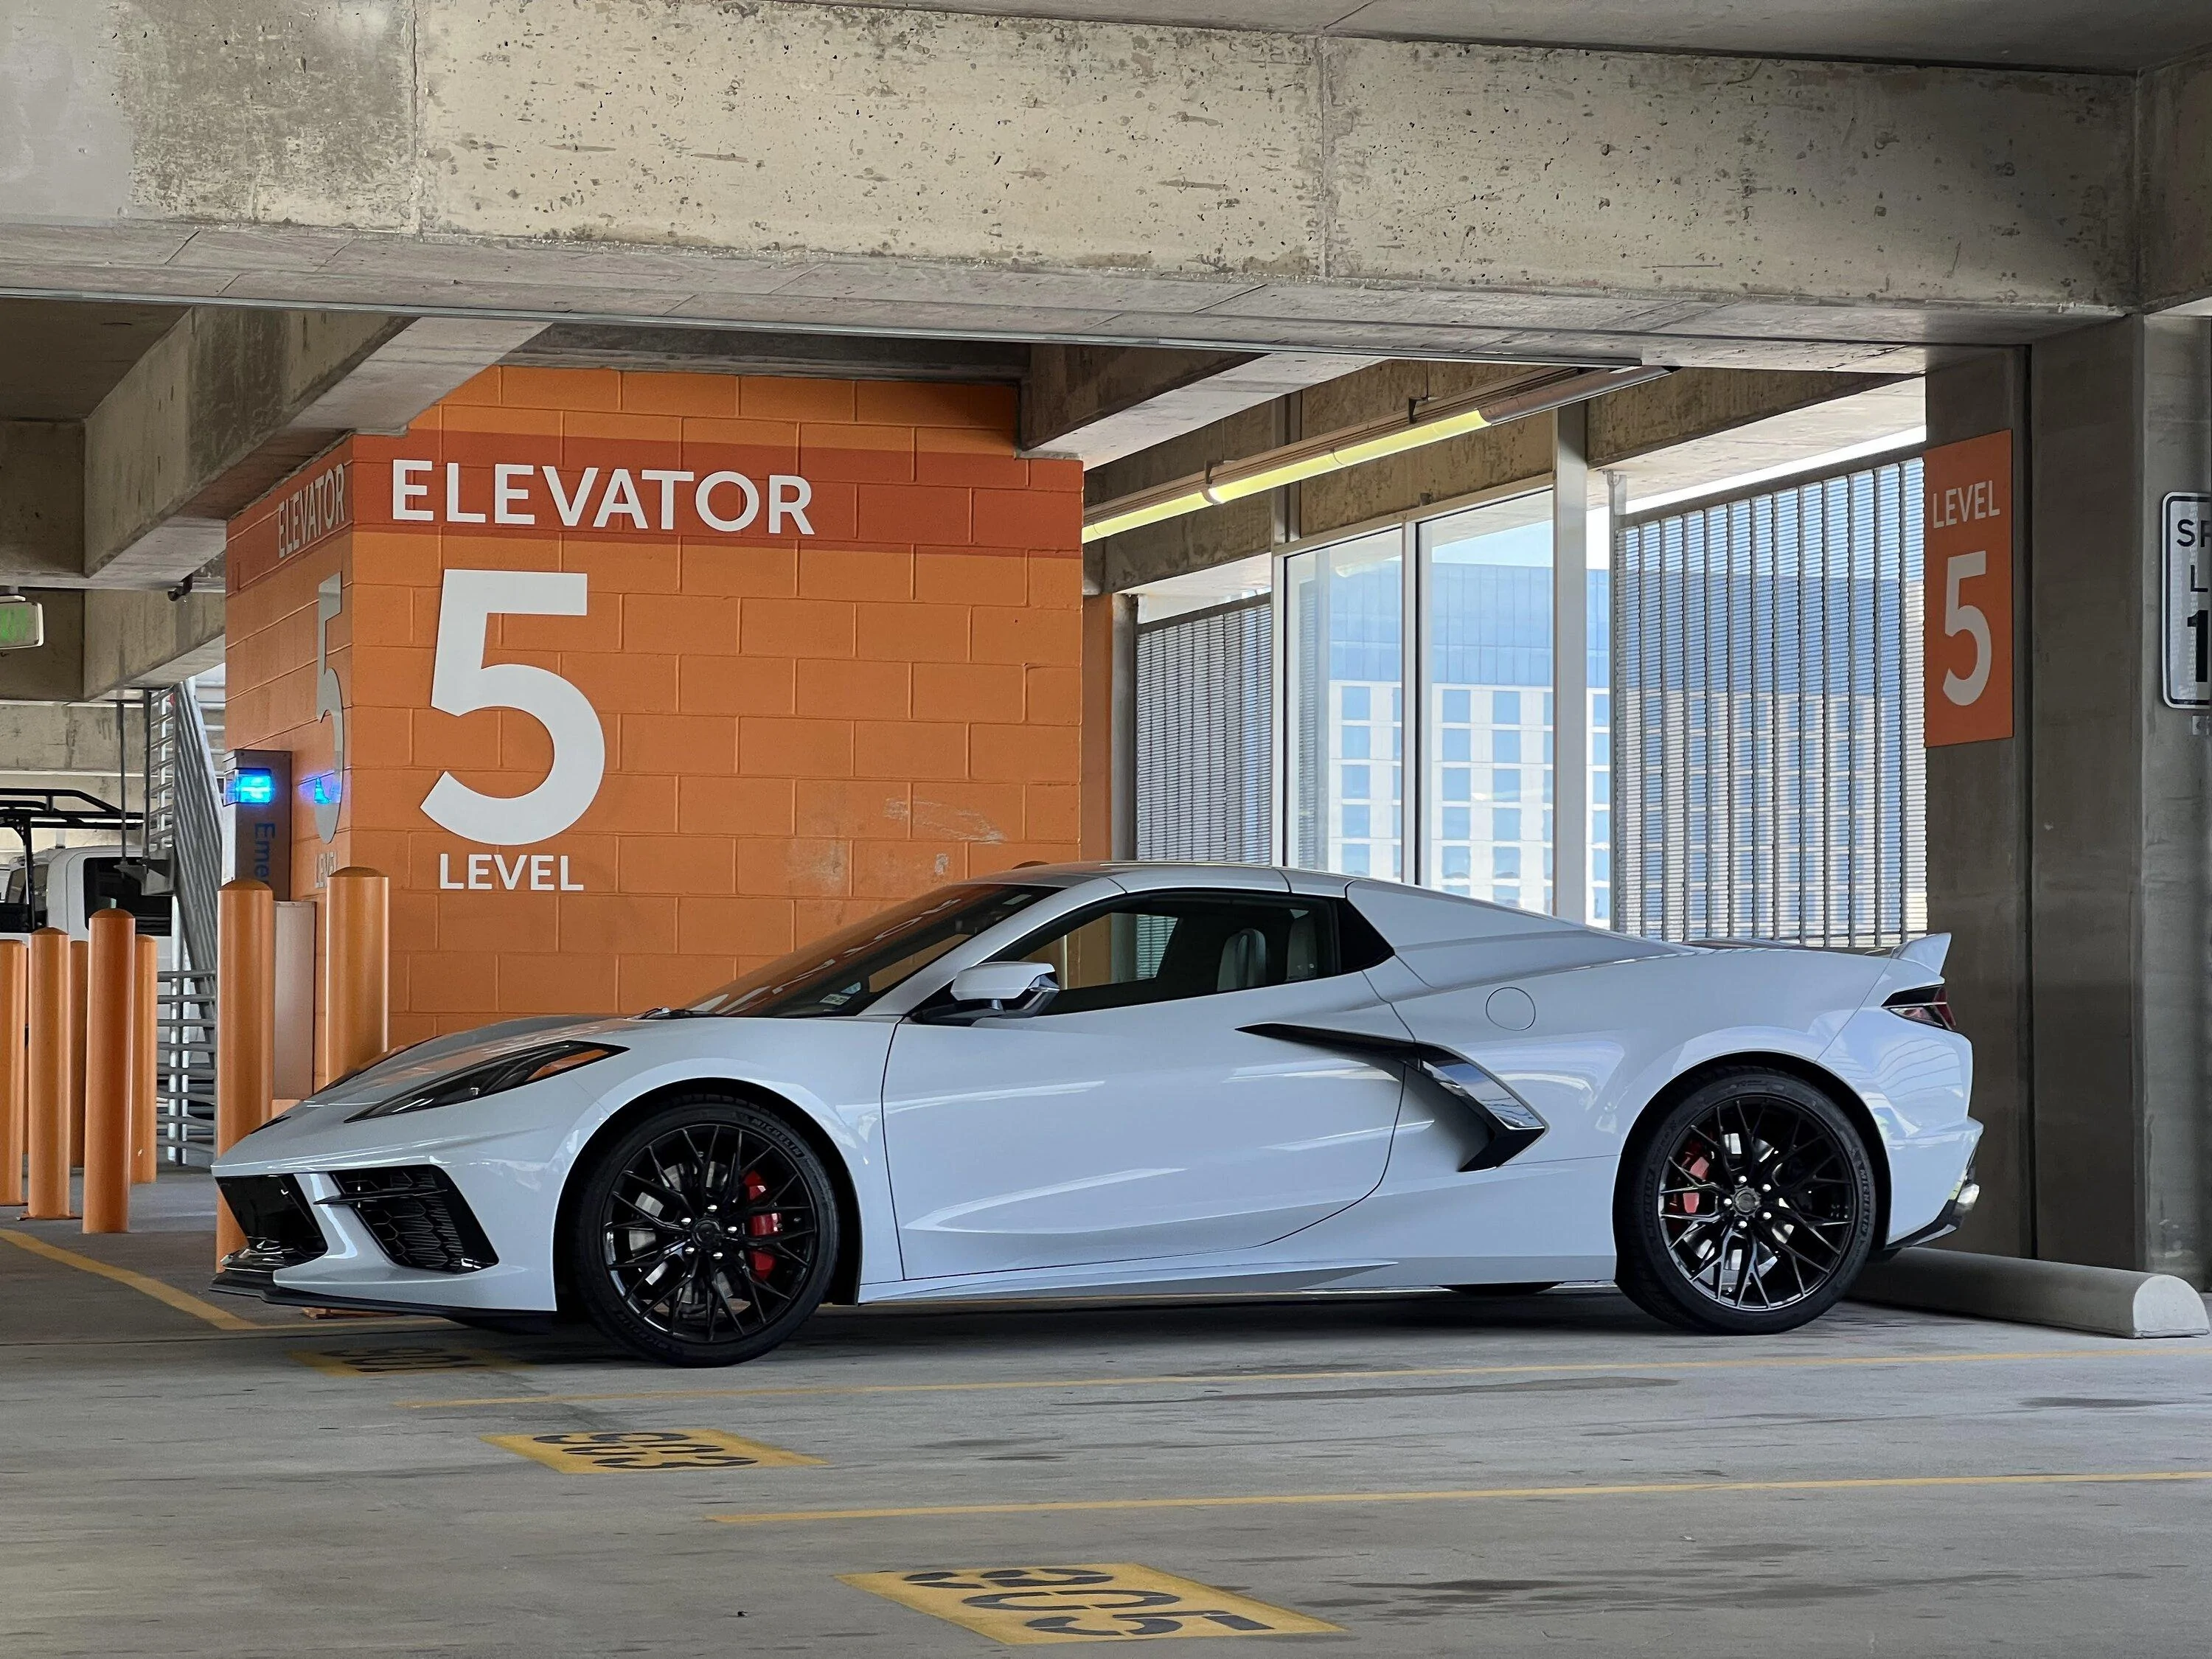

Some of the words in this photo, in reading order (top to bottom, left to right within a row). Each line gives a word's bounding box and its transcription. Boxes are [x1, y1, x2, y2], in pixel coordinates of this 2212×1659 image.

[279, 463, 345, 559] ELEVATOR
[392, 459, 815, 535] ELEVATOR
[1933, 480, 2000, 529] LEVEL
[1943, 550, 1992, 706] 5
[314, 571, 344, 844] 5
[420, 568, 605, 846] 5
[440, 853, 584, 891] LEVEL
